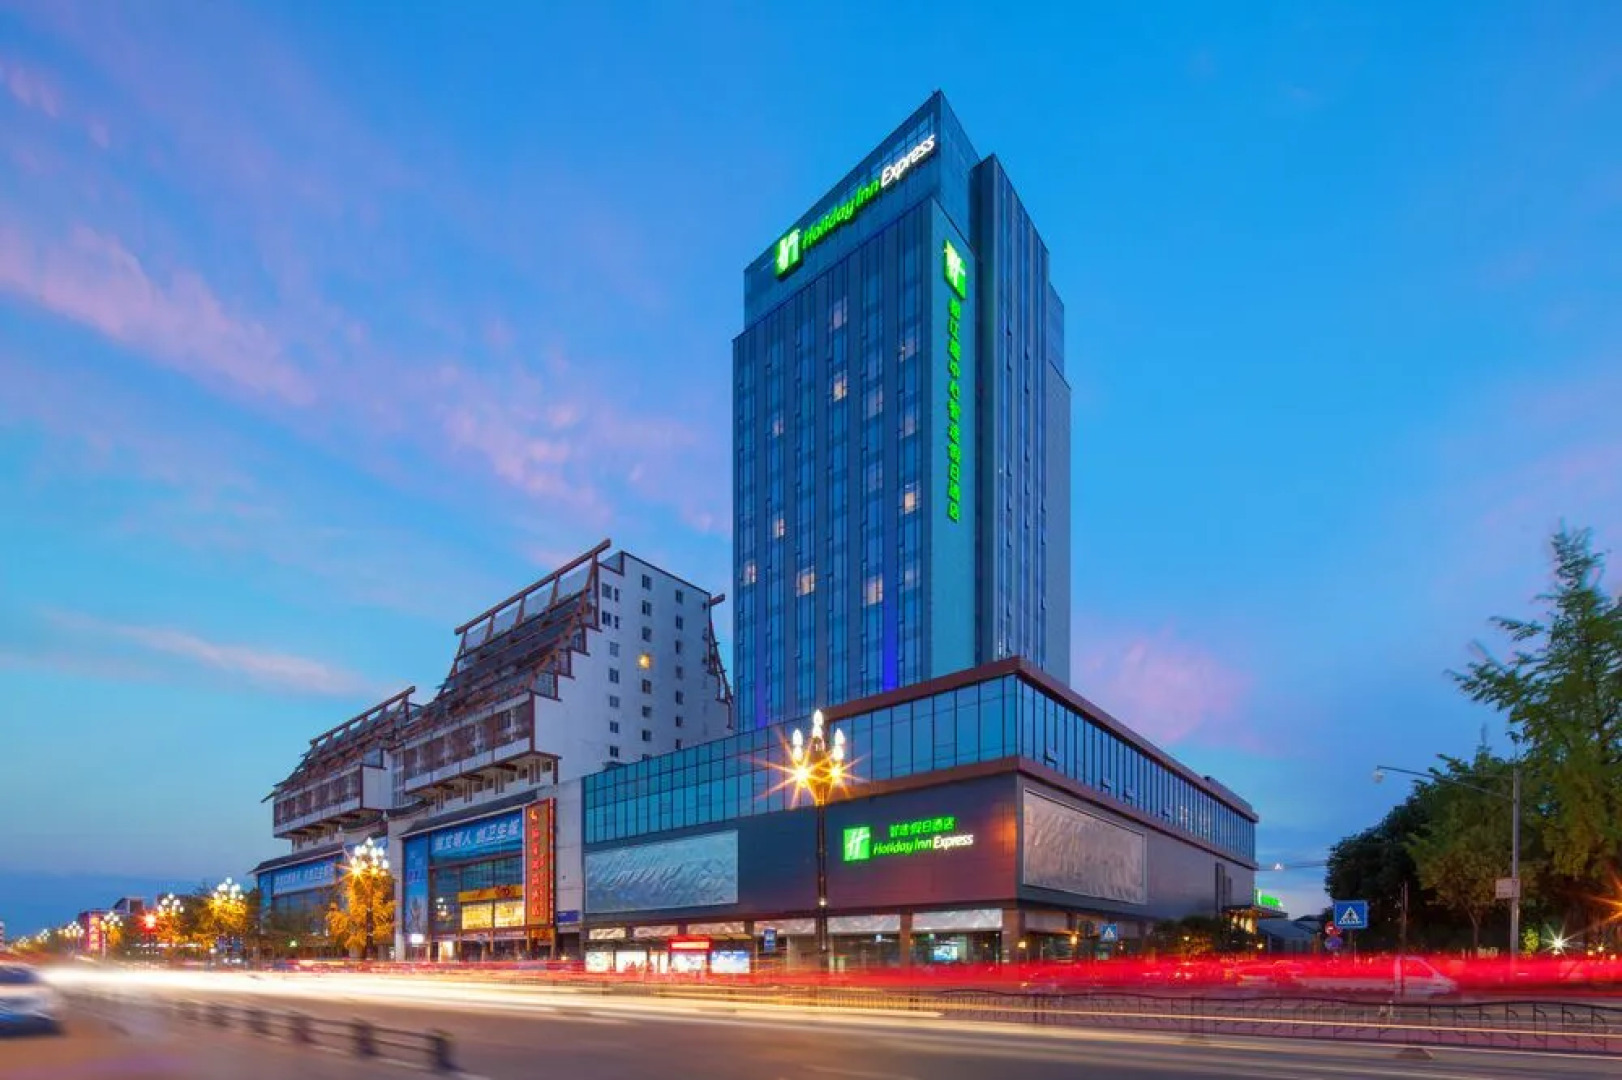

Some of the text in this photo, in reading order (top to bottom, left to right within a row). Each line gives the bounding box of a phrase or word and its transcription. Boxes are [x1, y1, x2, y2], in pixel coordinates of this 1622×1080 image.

[802, 134, 935, 248] Holiday Inn Express
[873, 834, 974, 855] Holiday Inn Express
